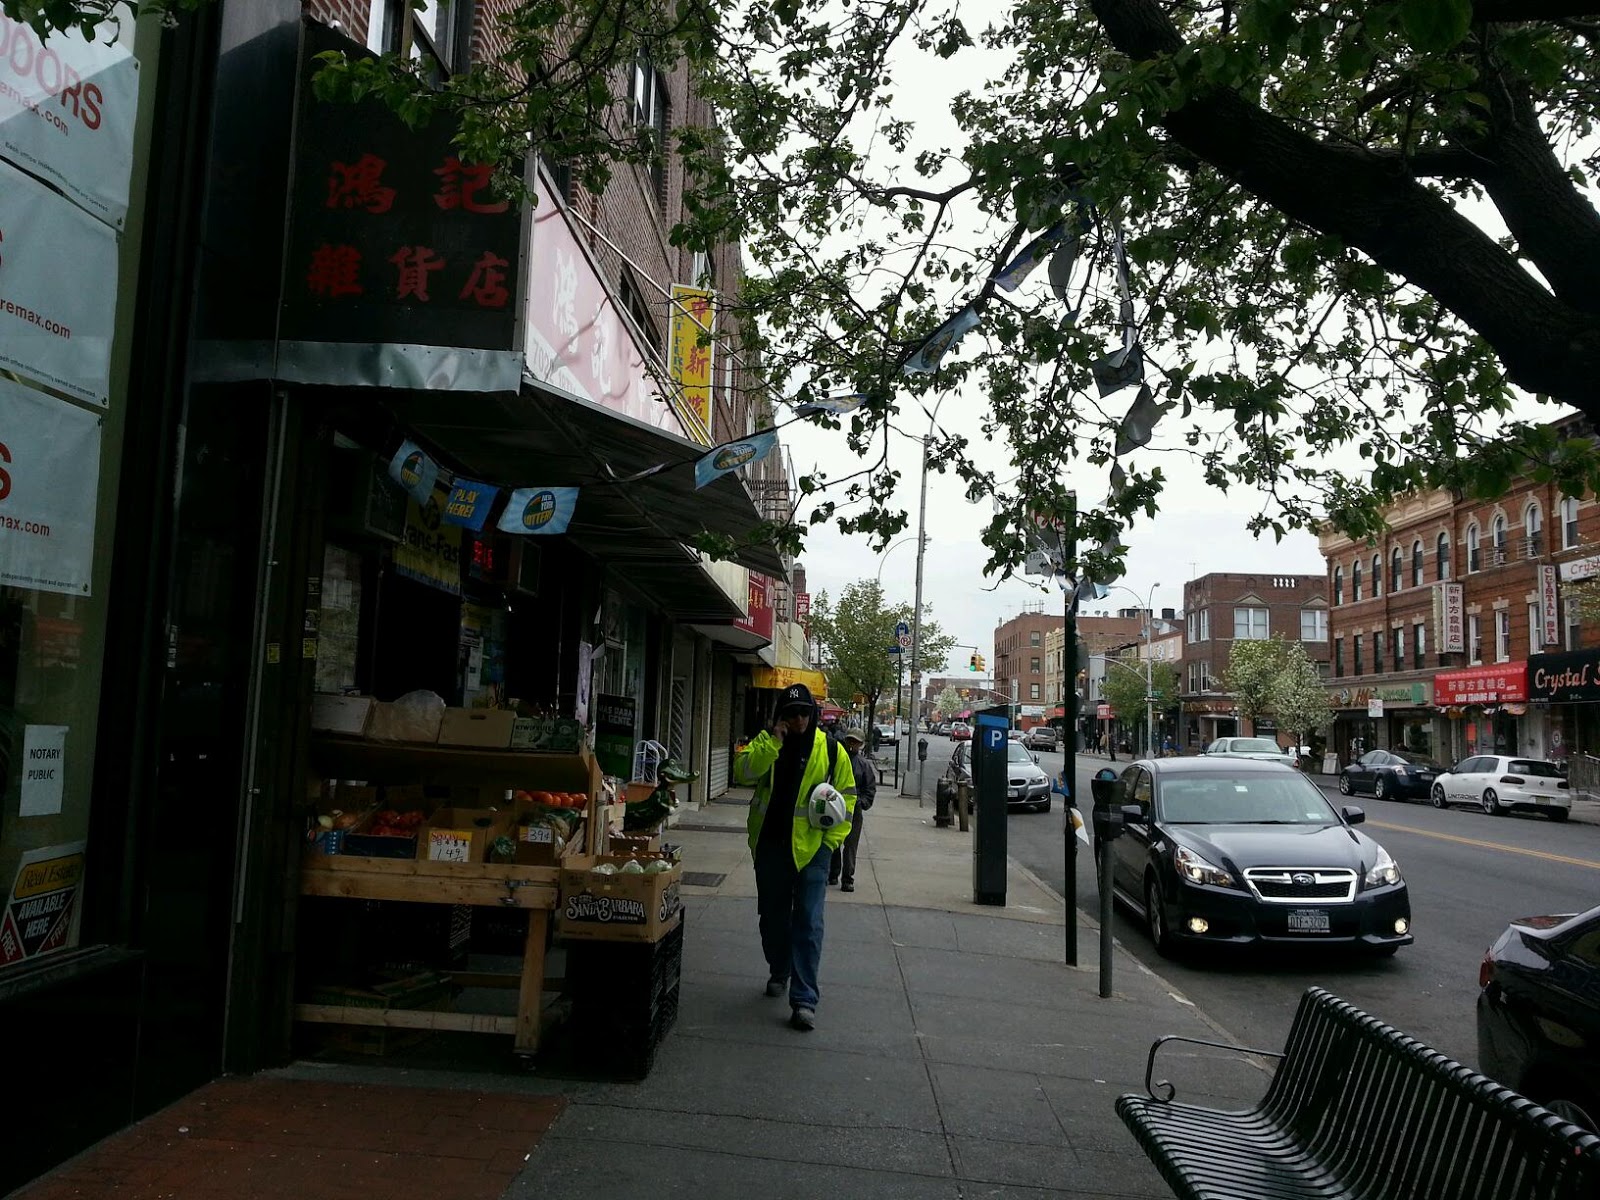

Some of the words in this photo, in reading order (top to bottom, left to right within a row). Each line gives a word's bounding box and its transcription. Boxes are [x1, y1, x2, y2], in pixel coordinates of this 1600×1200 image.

[455, 488, 480, 502] PLAY
[446, 503, 475, 518] HERE!
[1534, 663, 1590, 696] Crystal
[990, 729, 1003, 747] P
[29, 748, 61, 760] NOTARY
[27, 769, 55, 780] PUBLIC
[22, 866, 48, 889] Real
[17, 892, 67, 921] AVAILABLE
[598, 897, 645, 922] BARBARA
[24, 916, 51, 940] HERE
